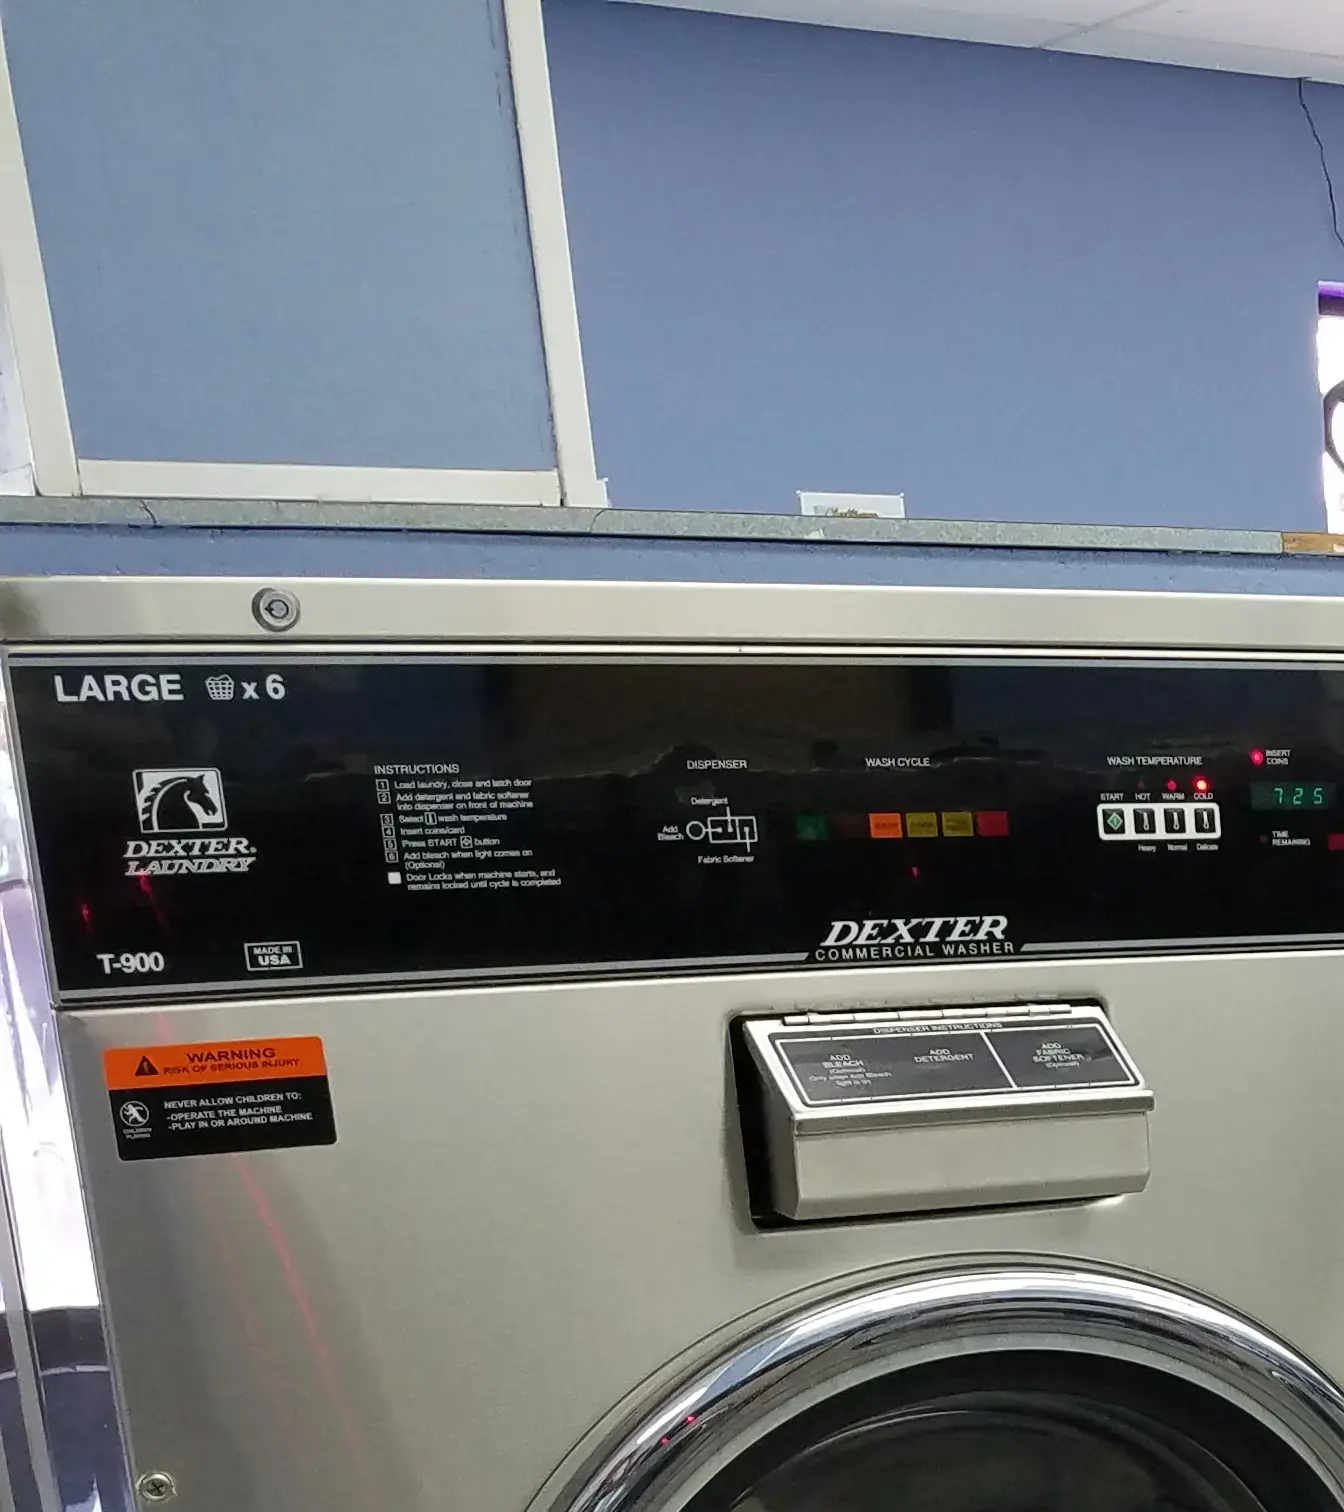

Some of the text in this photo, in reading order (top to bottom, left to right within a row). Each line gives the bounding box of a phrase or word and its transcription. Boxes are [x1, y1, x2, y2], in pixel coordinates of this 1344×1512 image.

[54, 674, 285, 702] LARGE x 6
[687, 759, 747, 770] DISPENSER
[866, 757, 930, 768] WASH CYCLE
[1107, 756, 1203, 765] WASH TEMPERATURE
[374, 764, 459, 774] INSTRUCTIONS
[1194, 792, 1213, 800] COLD
[124, 855, 255, 876] LAUNDRY
[820, 916, 1007, 946] DEXTER
[253, 946, 280, 954] MADE
[816, 942, 1014, 961] COMMERCIAL WASHER
[97, 952, 165, 974] T-900
[258, 954, 291, 966] USA
[186, 1048, 276, 1063] WARNING
[914, 1053, 974, 1063] DETERGENT
[164, 1058, 300, 1075] RISK OF SERIOUS INJURY
[164, 1100, 197, 1109] NEVER
[200, 1097, 233, 1107] ALLOW
[236, 1093, 283, 1104] CHILDREN
[218, 1109, 237, 1118] THE
[239, 1106, 282, 1116] MACHINE
[199, 1120, 208, 1128] IN
[211, 1118, 224, 1127] OR
[227, 1115, 267, 1127] AROUND
[270, 1112, 313, 1124] MACHINE
